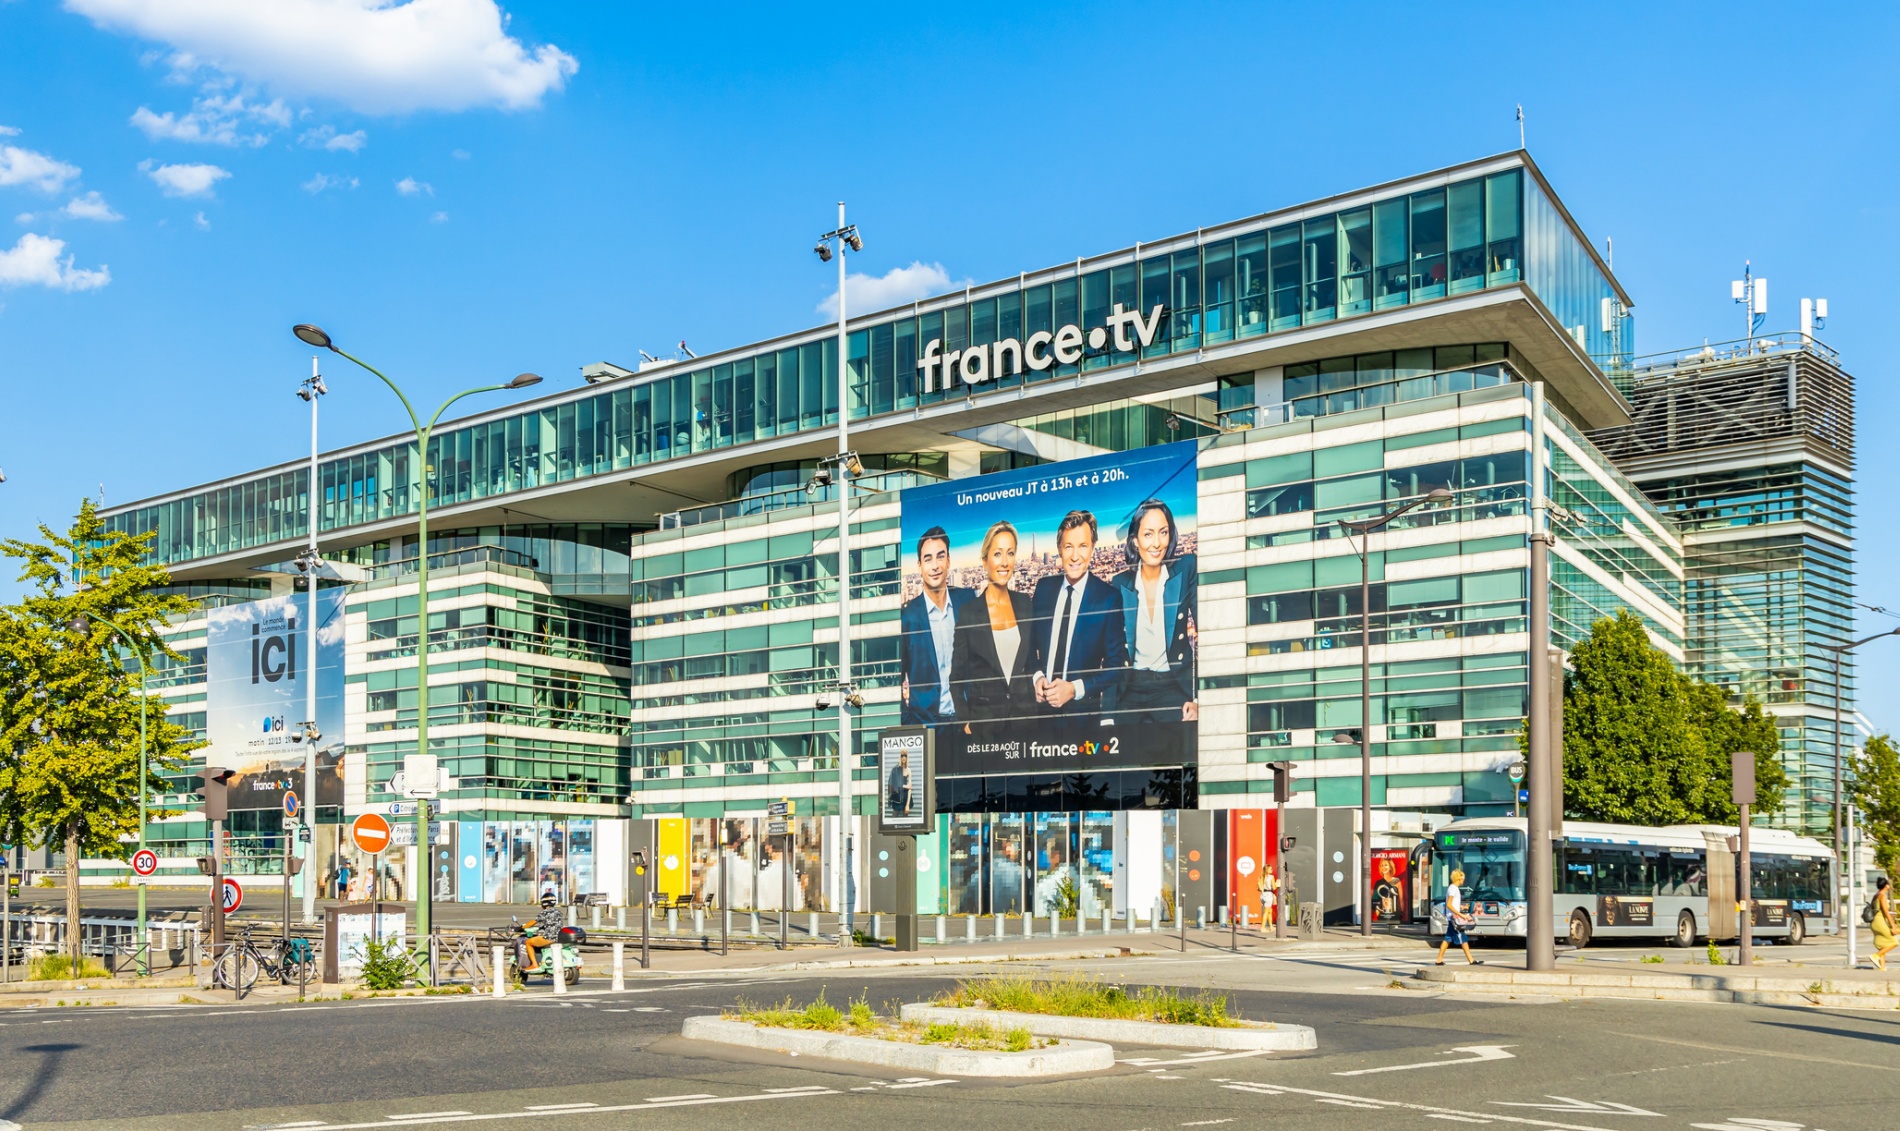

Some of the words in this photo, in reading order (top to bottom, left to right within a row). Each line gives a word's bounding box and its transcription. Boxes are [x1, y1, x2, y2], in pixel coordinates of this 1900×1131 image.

[957, 493, 973, 506] Un
[975, 486, 1023, 503] nouveau
[1025, 481, 1039, 495] JT
[1040, 480, 1049, 493] à
[1051, 477, 1072, 491] 13h
[1075, 474, 1088, 487] et
[1091, 472, 1100, 485] à
[1102, 467, 1130, 483] 20h.
[261, 624, 286, 633] commence
[252, 617, 296, 685] ici
[271, 715, 284, 732] ici
[883, 736, 923, 749] MANGO
[967, 742, 981, 754] DÈS
[981, 744, 990, 753] LE
[990, 743, 1000, 752] 28
[1000, 740, 1021, 751] AOÛT
[1005, 751, 1020, 760] SUR
[1510, 766, 1523, 774] BUS
[1444, 835, 1455, 846] PC
[138, 857, 153, 868] 30
